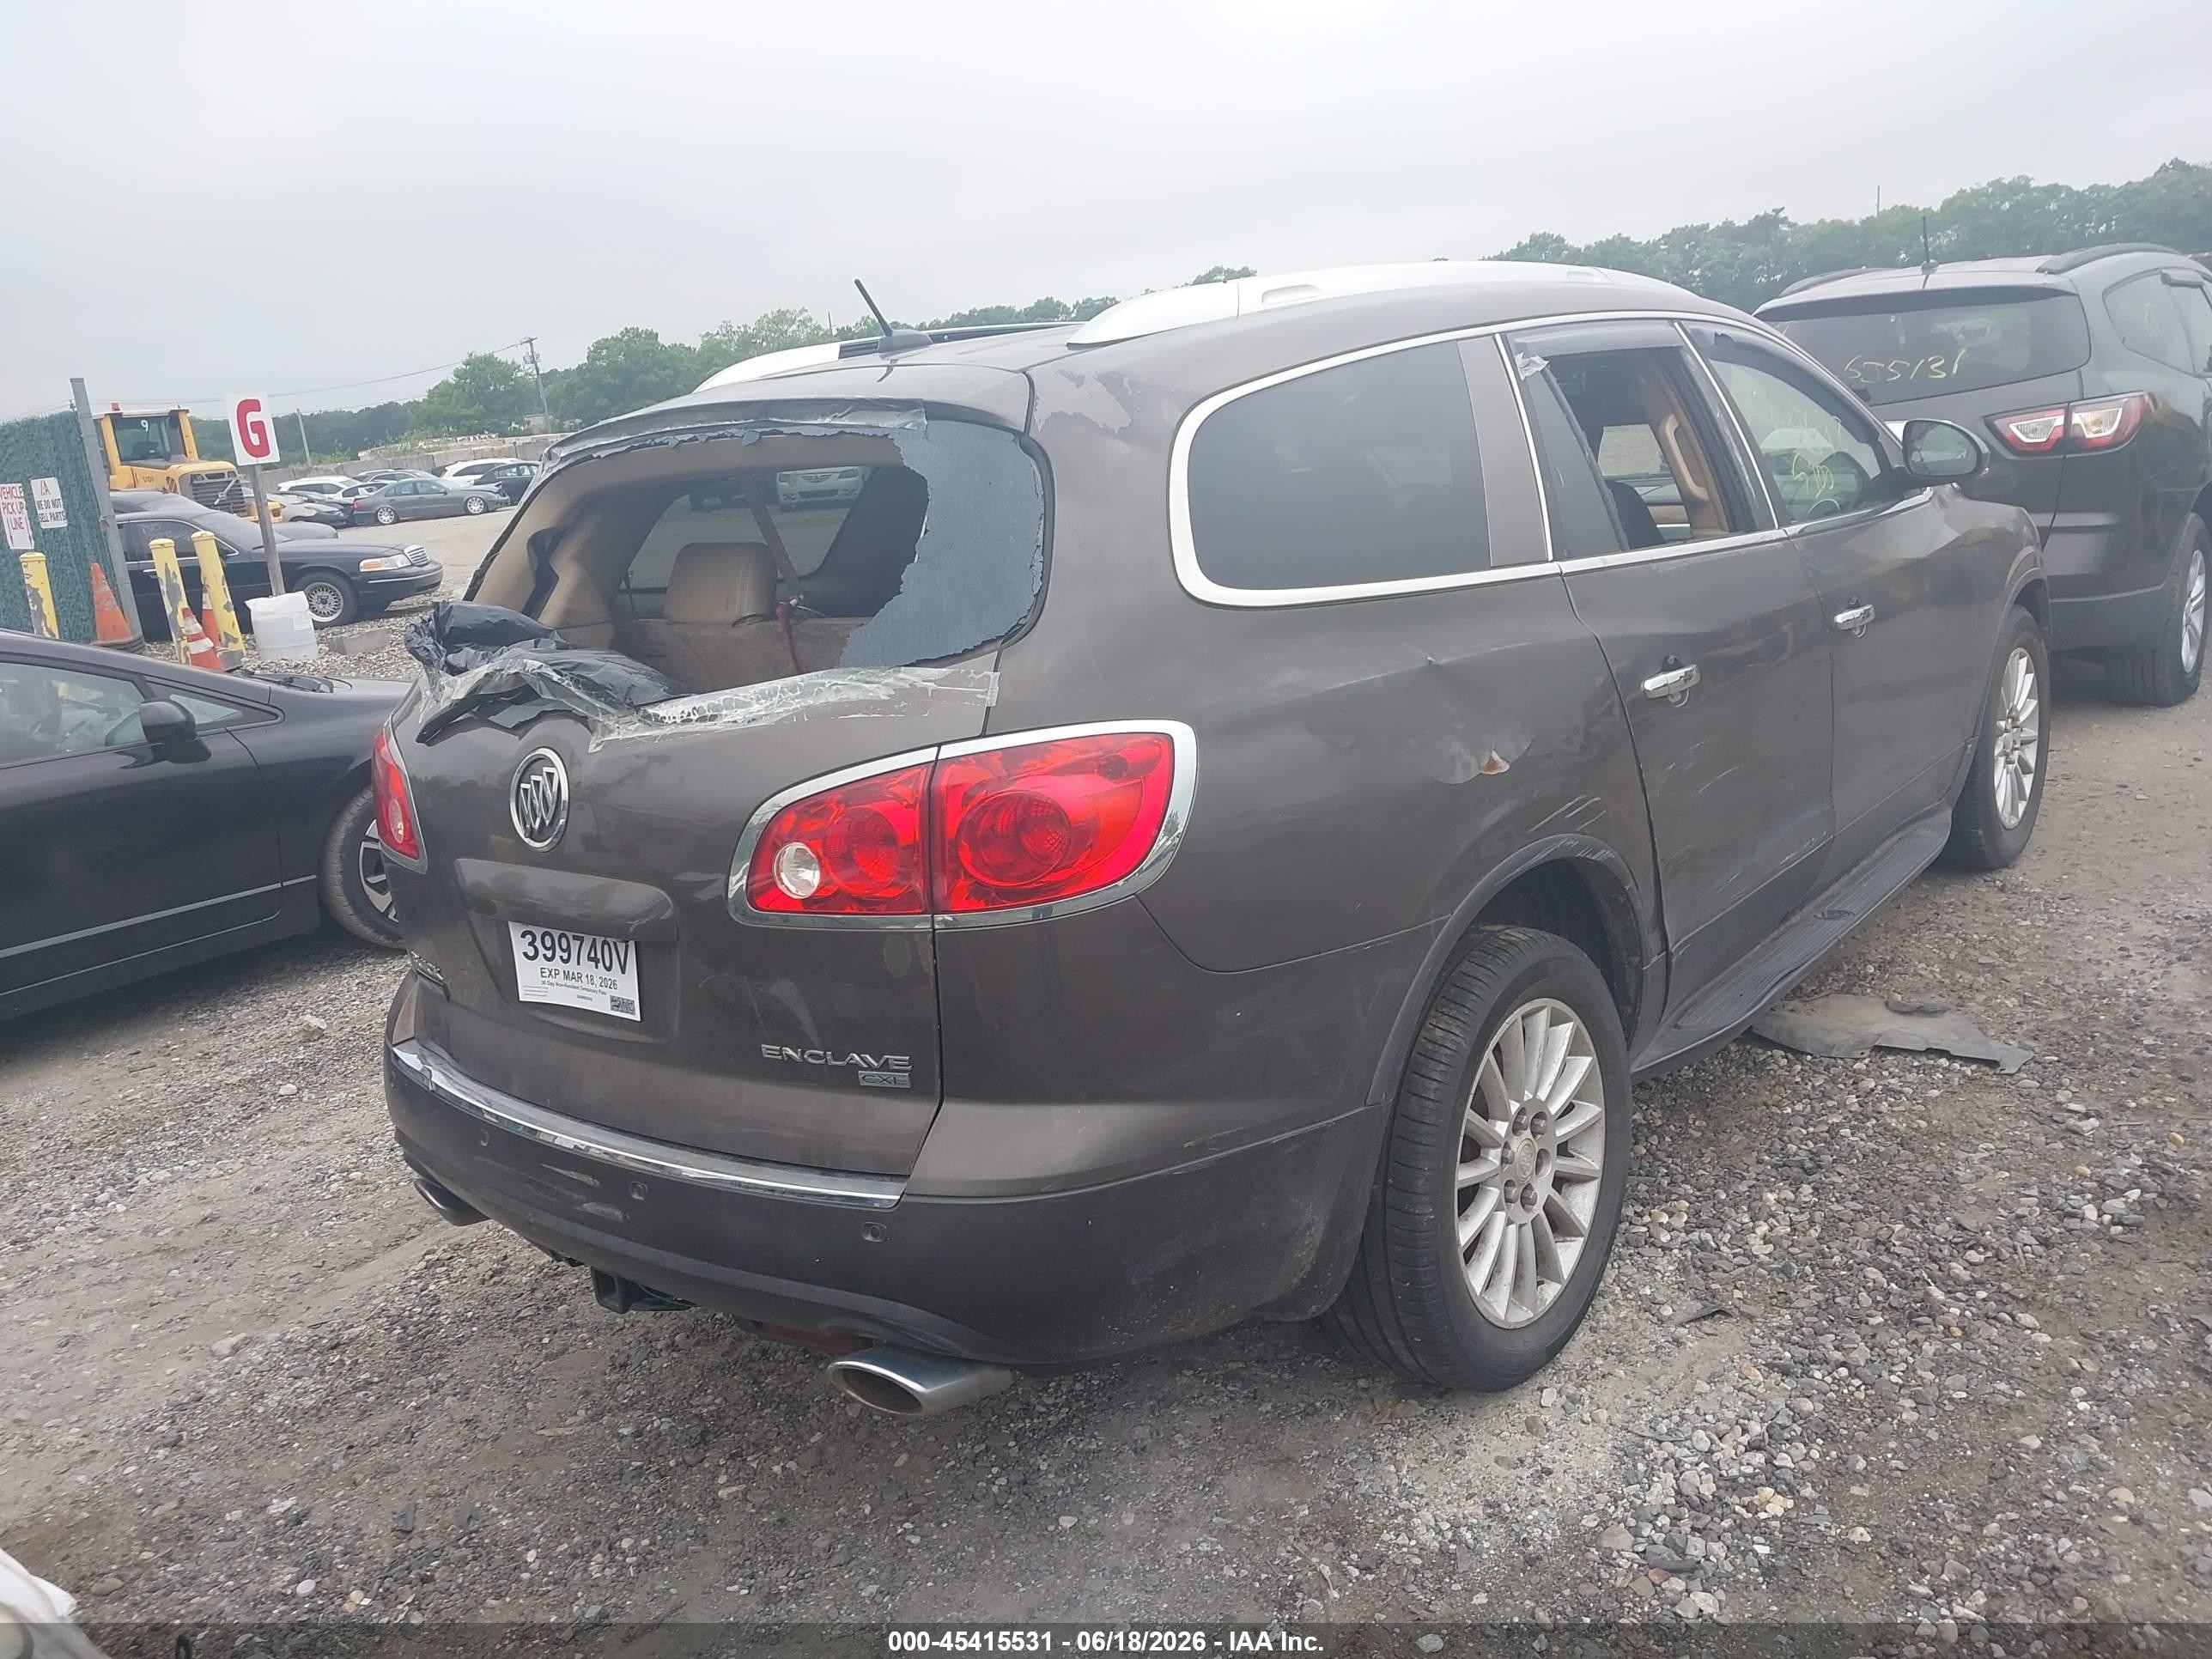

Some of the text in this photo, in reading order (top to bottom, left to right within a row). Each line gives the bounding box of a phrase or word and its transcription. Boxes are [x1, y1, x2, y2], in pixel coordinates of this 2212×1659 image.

[140, 419, 149, 432] 9
[236, 398, 270, 459] G
[520, 930, 629, 975] 399740V
[540, 967, 618, 990] EXP MAR 18, 2026
[761, 1043, 913, 1070] ENCLAVE
